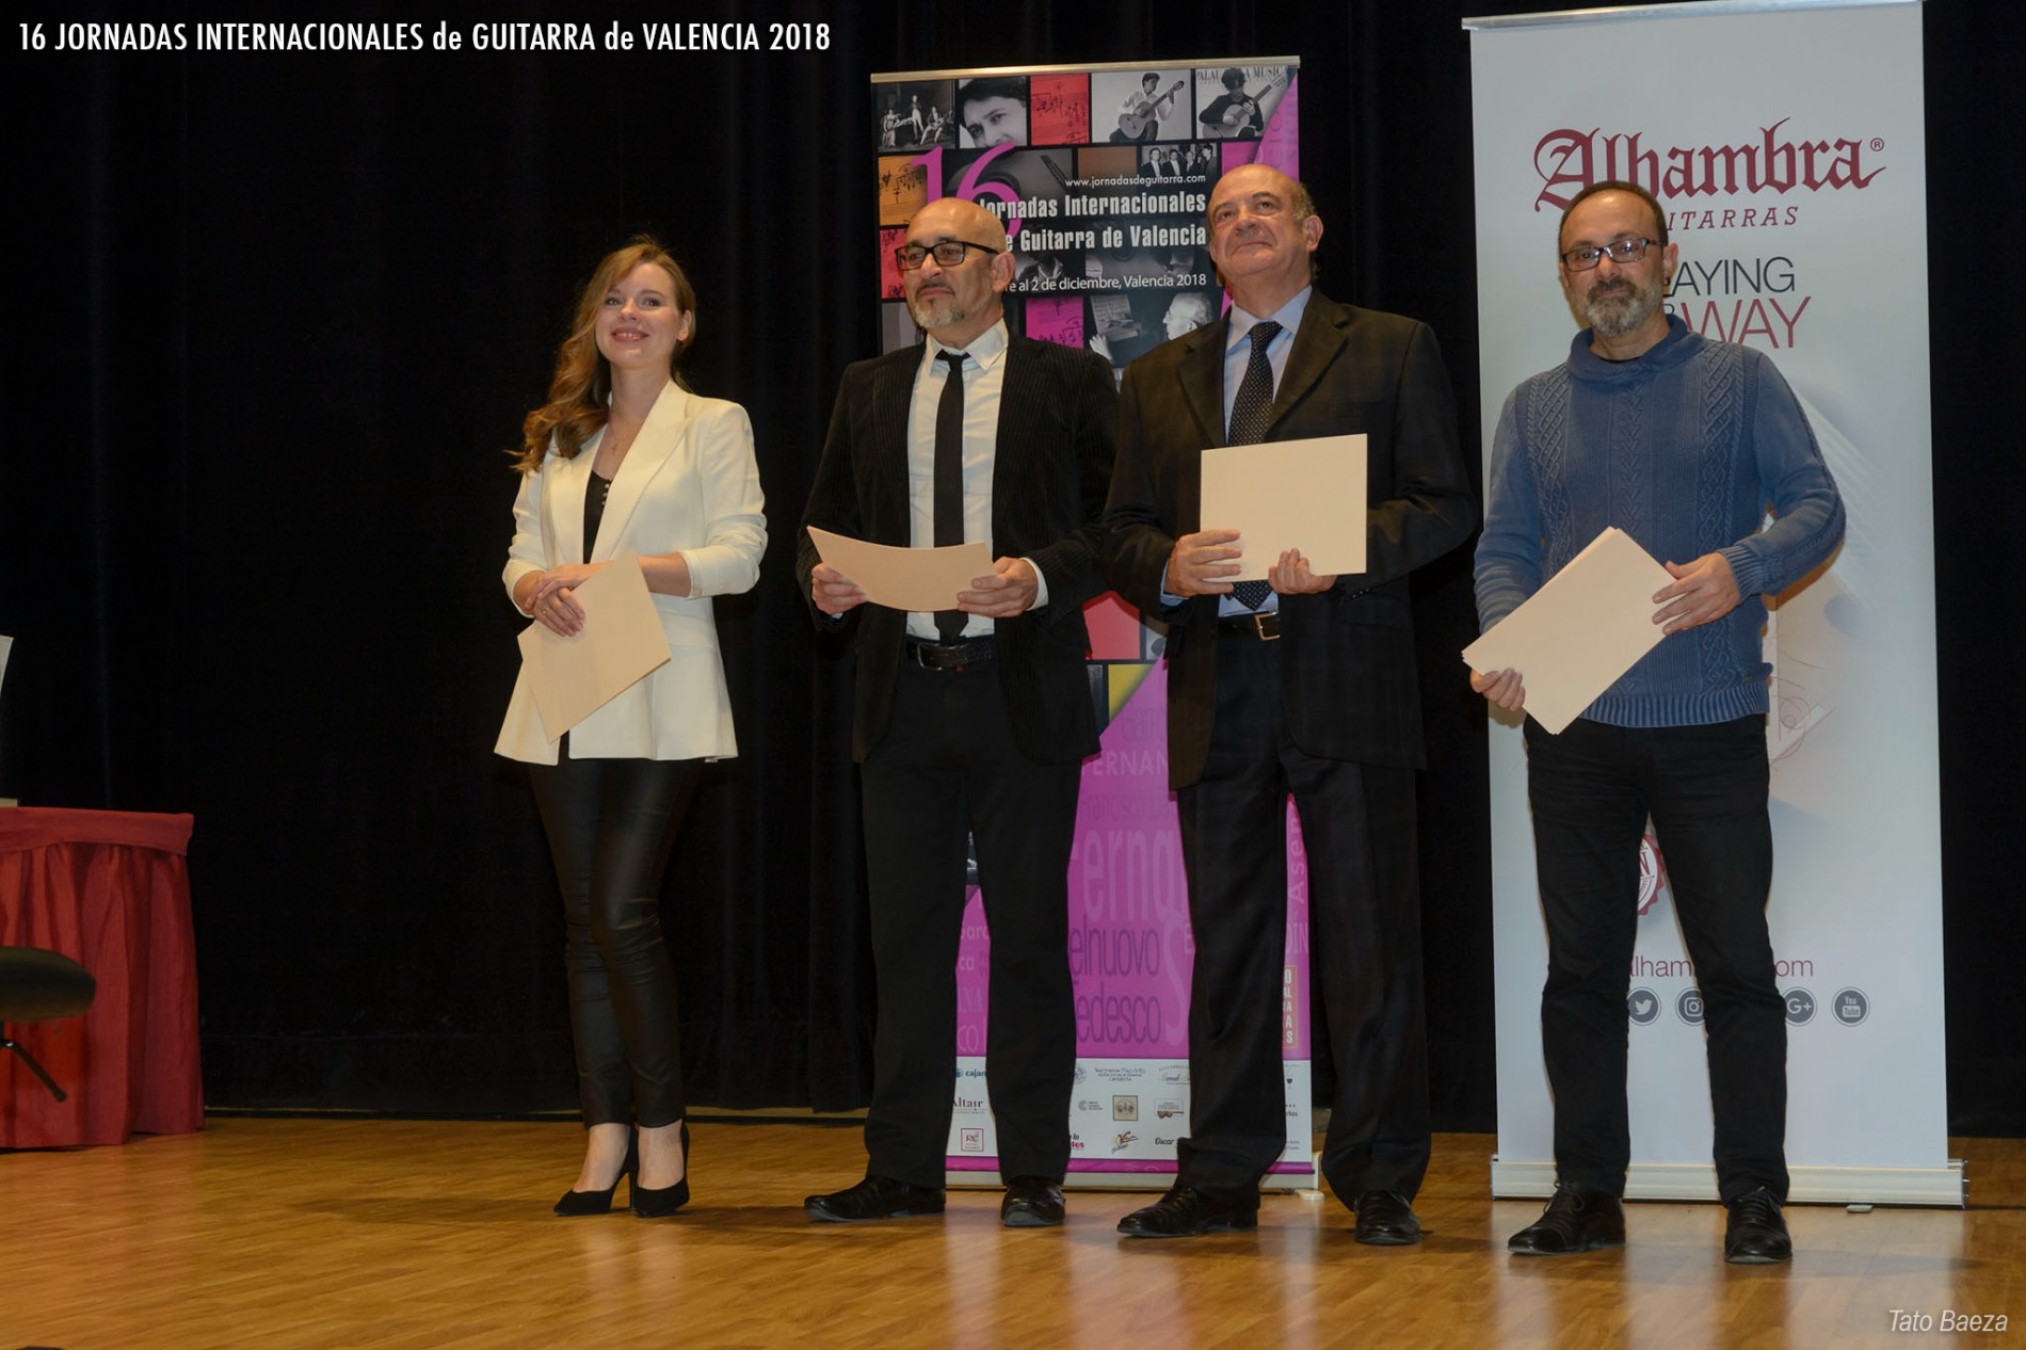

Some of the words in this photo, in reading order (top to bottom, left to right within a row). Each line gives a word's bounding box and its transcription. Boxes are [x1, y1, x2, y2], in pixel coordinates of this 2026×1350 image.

[1065, 174, 1206, 188] www.jornadasdeguitarra.com
[1065, 190, 1206, 216] Internacionales
[1667, 206, 1798, 231] ITARRAS
[1020, 228, 1095, 252] Guitarra
[1102, 226, 1123, 249] de
[1130, 224, 1206, 248] Valencia
[1018, 279, 1029, 292] al
[1031, 279, 1039, 291] 2
[1042, 277, 1056, 291] de
[1059, 275, 1122, 291] diciembre,
[1123, 274, 1174, 288] Valencia
[1177, 273, 1207, 287] 2018
[1663, 256, 1795, 297] AYING
[1680, 296, 1812, 349] WAY
[1074, 981, 1162, 1045] edesco
